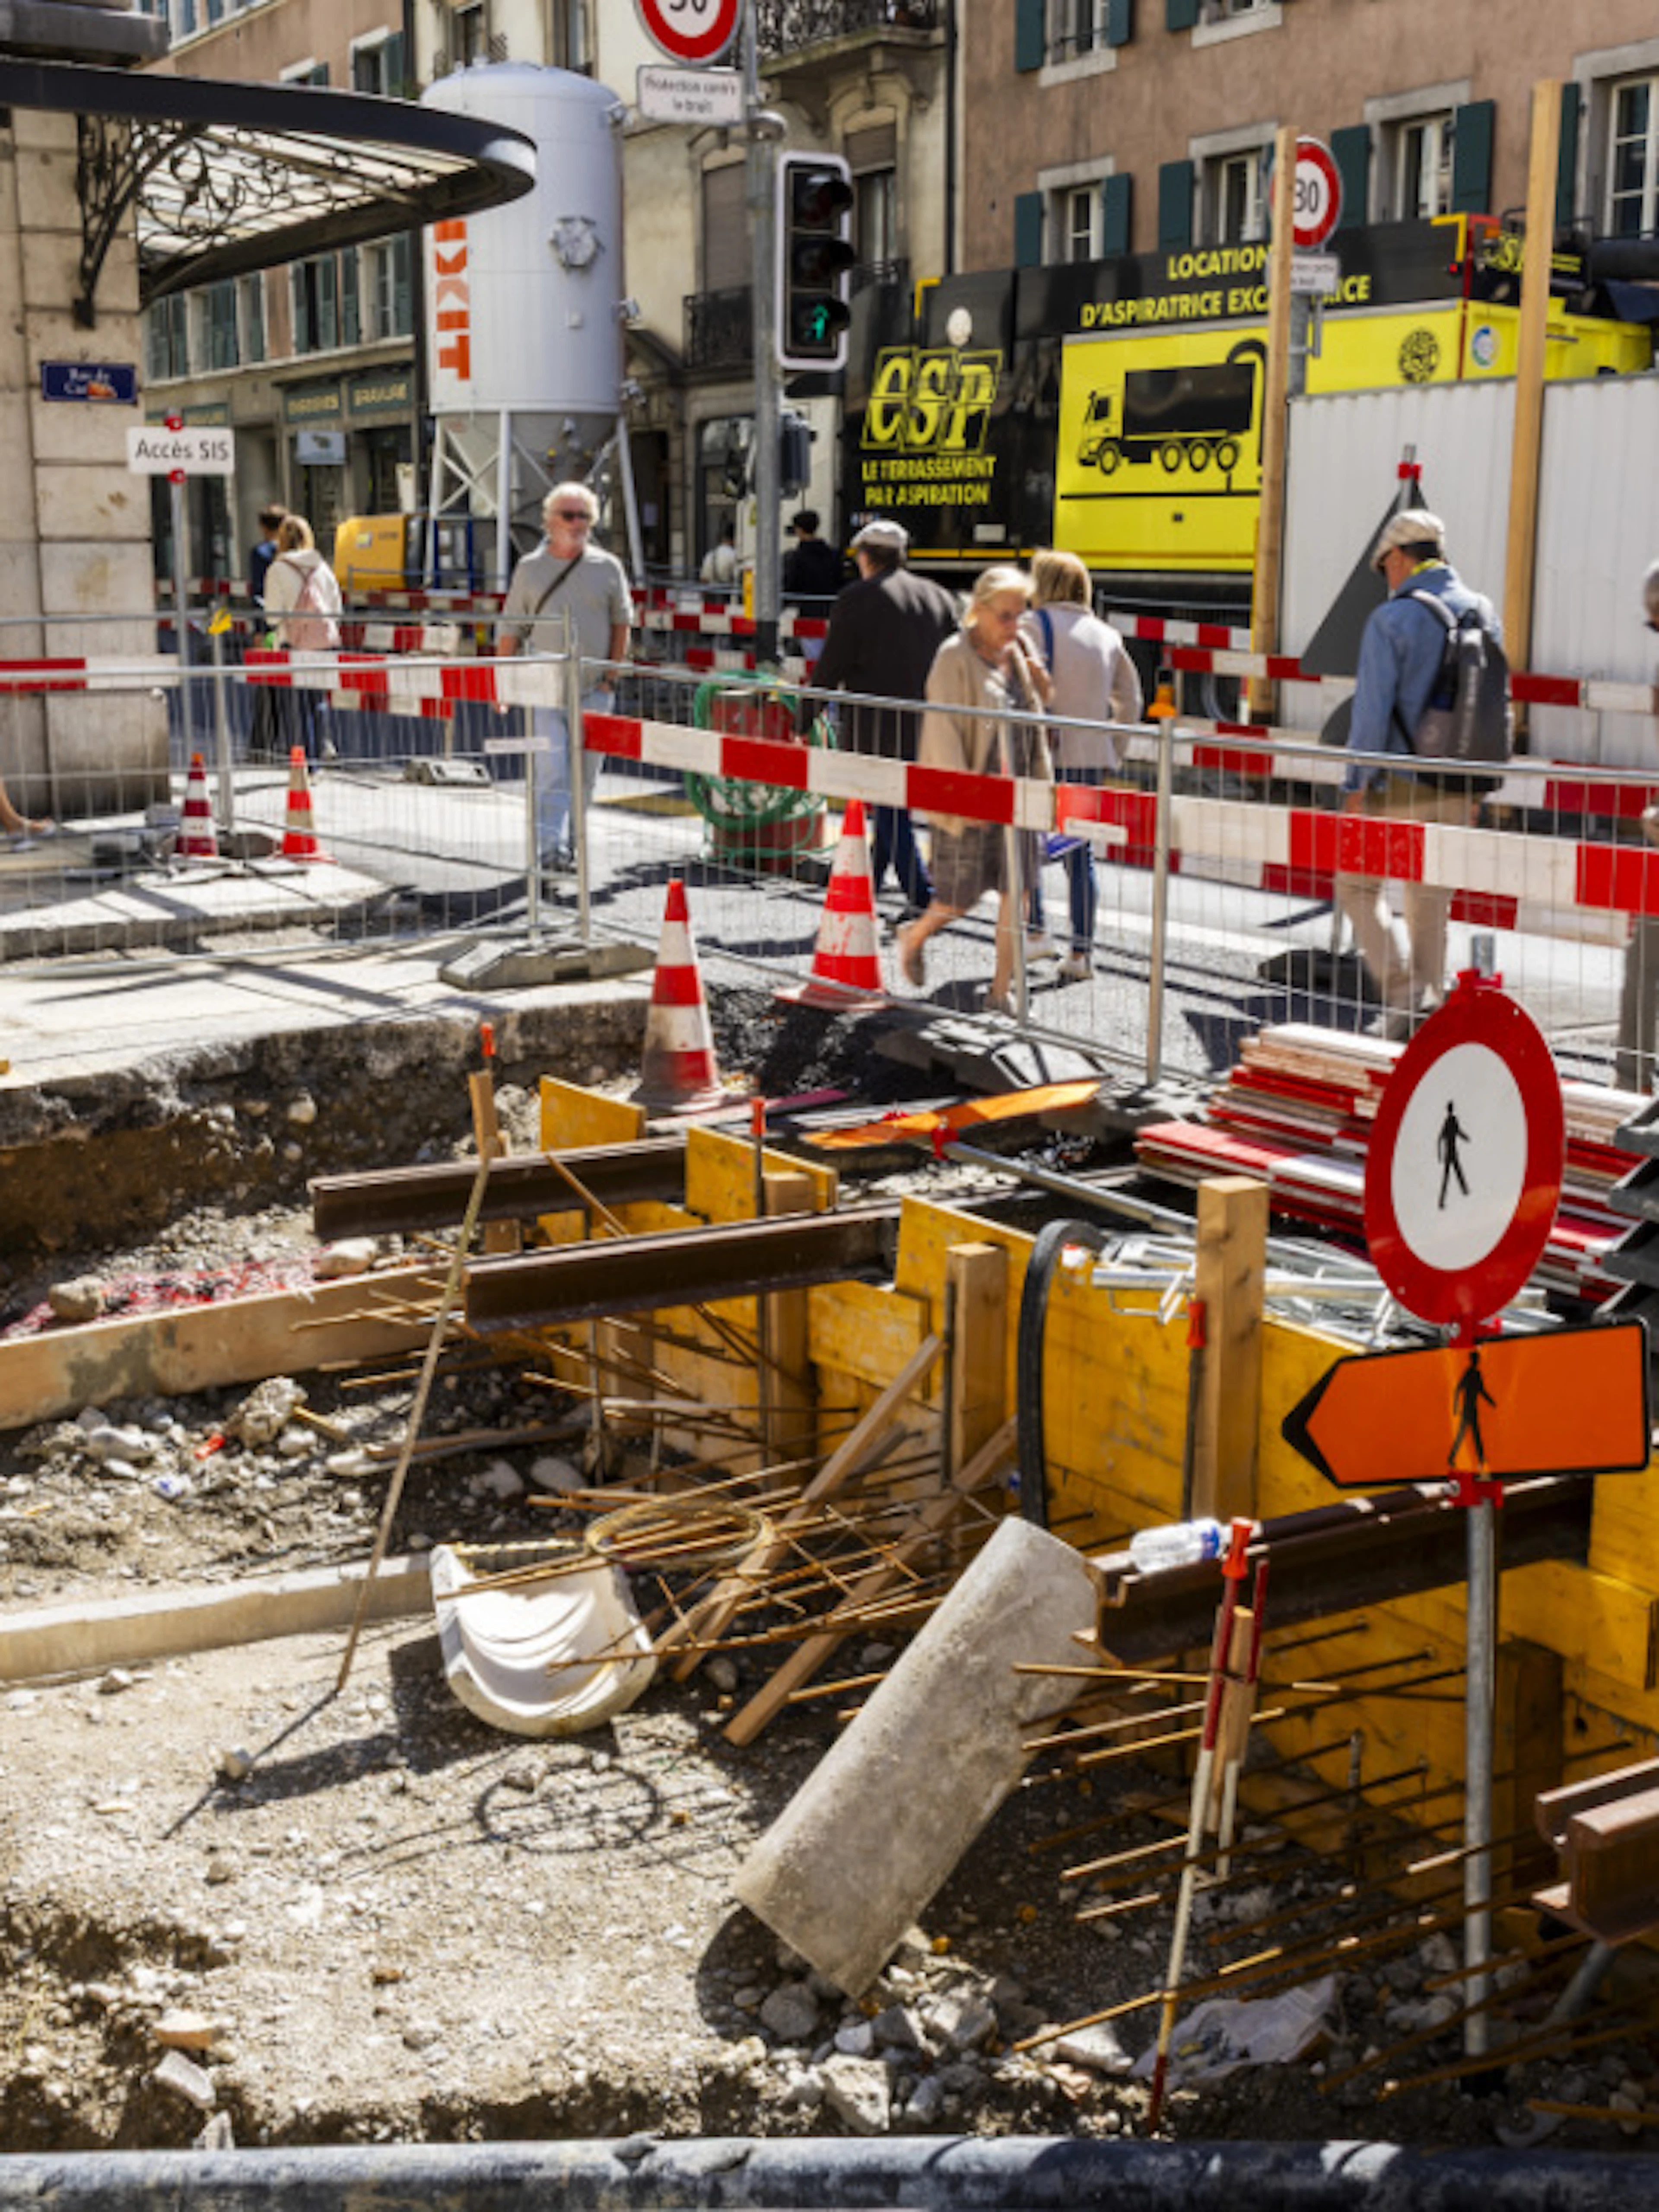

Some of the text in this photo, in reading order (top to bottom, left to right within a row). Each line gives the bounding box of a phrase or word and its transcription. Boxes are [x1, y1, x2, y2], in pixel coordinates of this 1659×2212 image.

[1293, 178, 1320, 213] 30
[1168, 245, 1273, 280] LOCATION
[1081, 289, 1224, 328] D'ASPIRATRICE
[135, 438, 229, 461] Accès SIS
[895, 482, 991, 506] ASPIRATION
